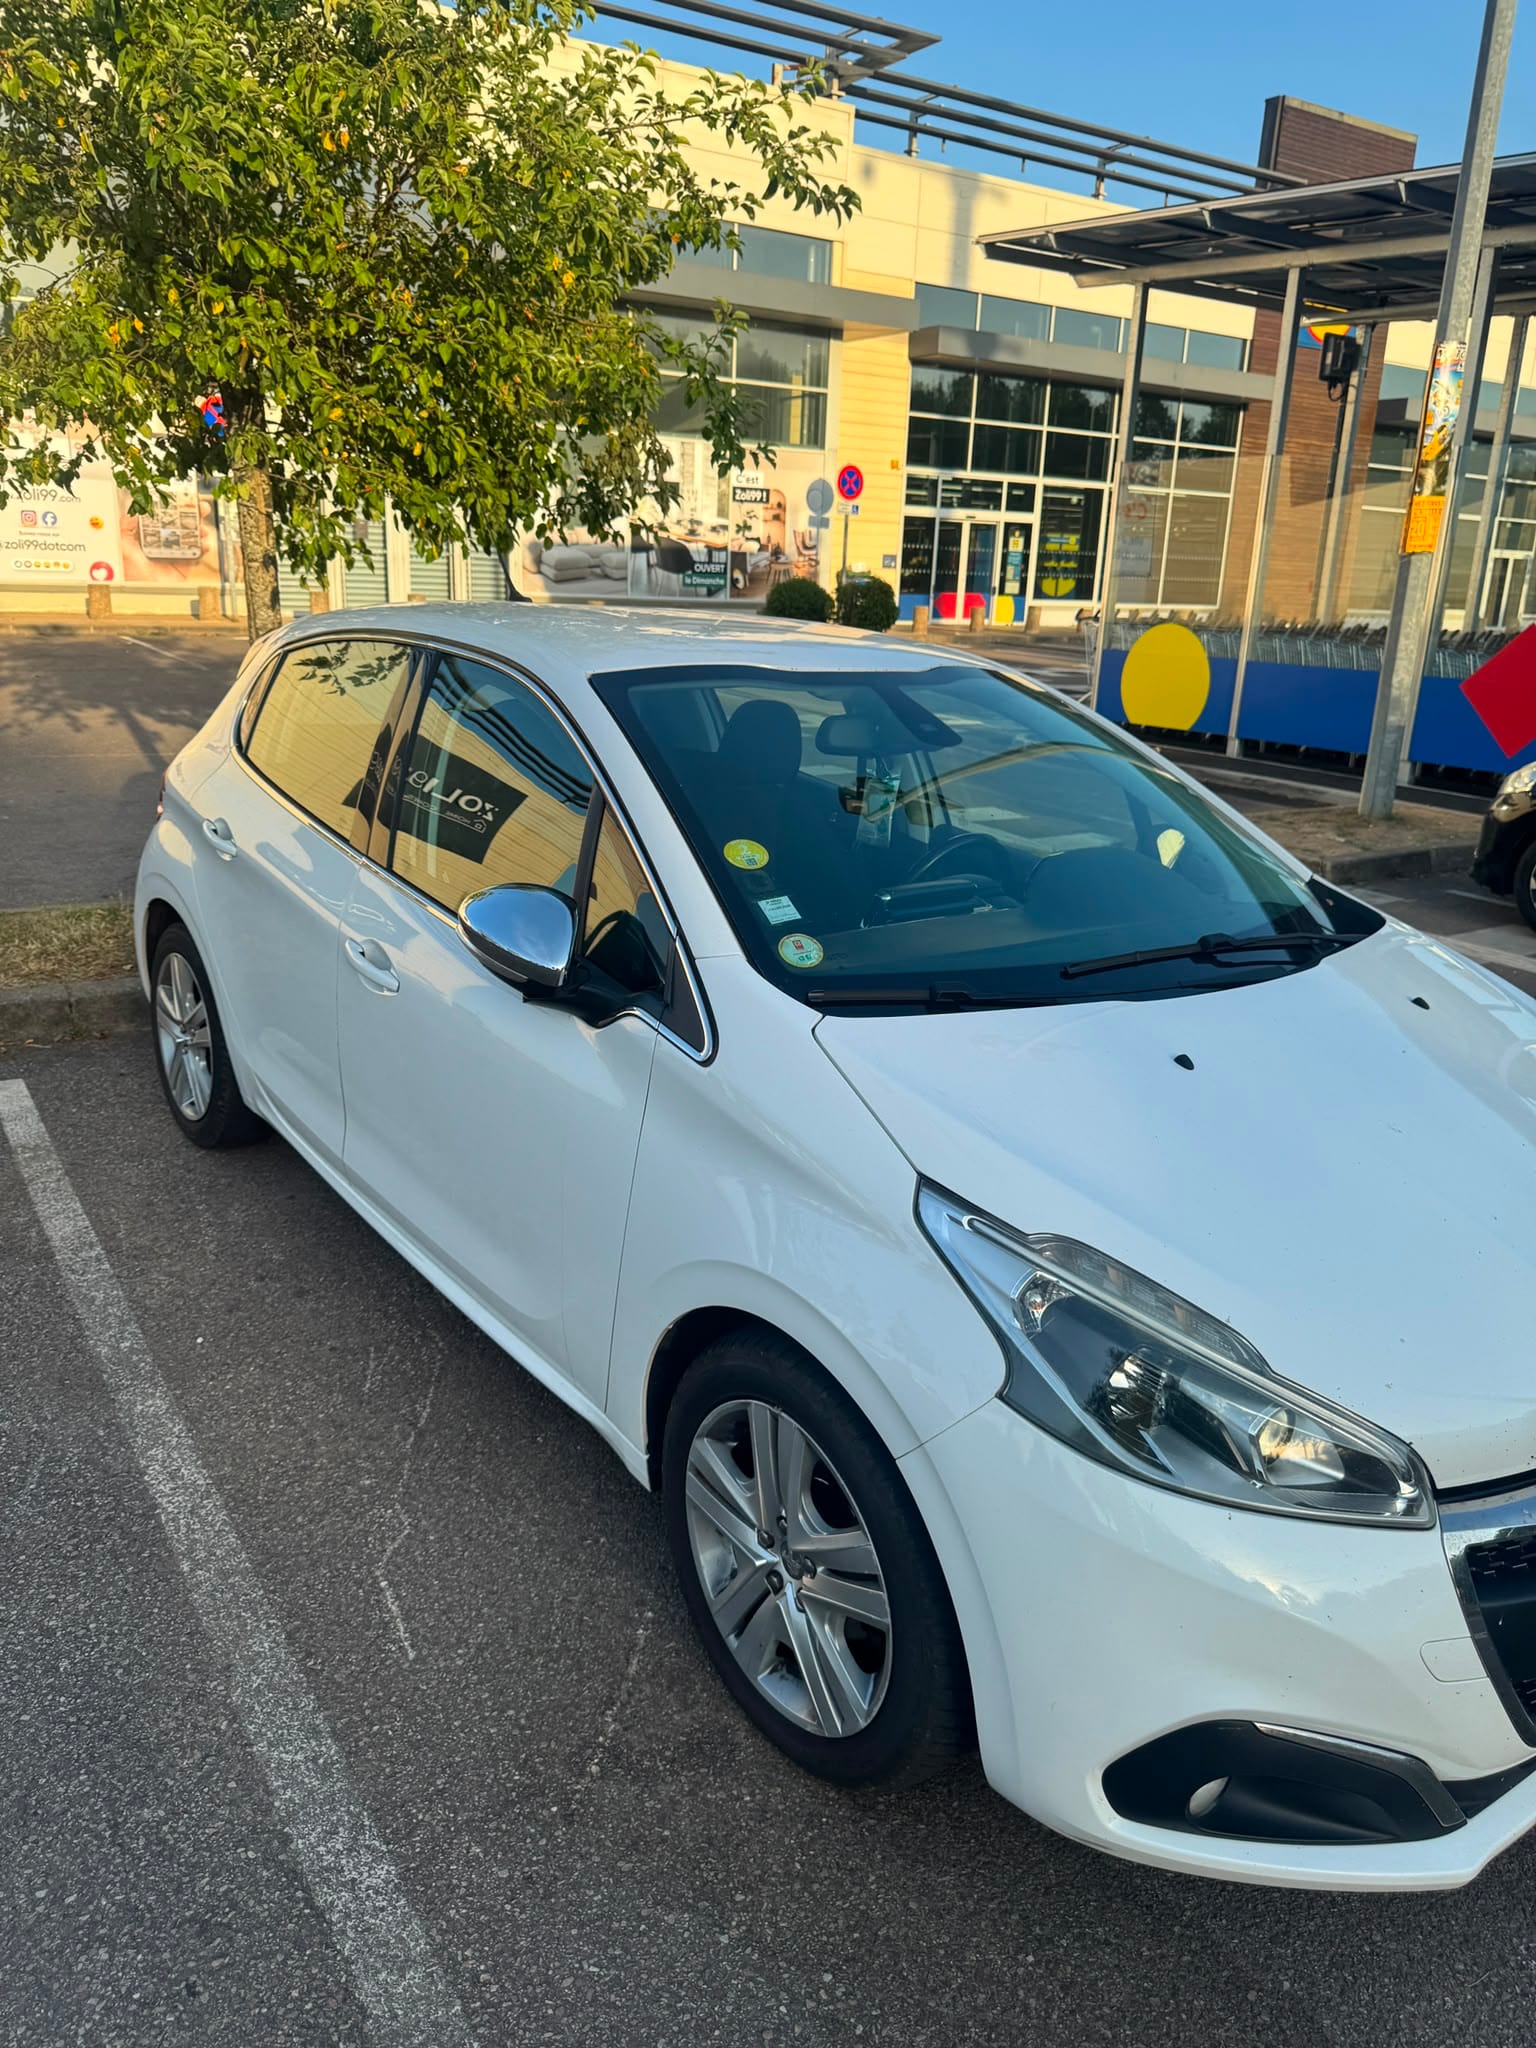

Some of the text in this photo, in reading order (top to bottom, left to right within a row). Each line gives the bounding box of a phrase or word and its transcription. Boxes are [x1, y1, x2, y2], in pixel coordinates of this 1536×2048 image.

[735, 489, 762, 502] Zoli99
[0, 539, 87, 552] zoli99dotcom
[694, 563, 725, 573] OUVERT
